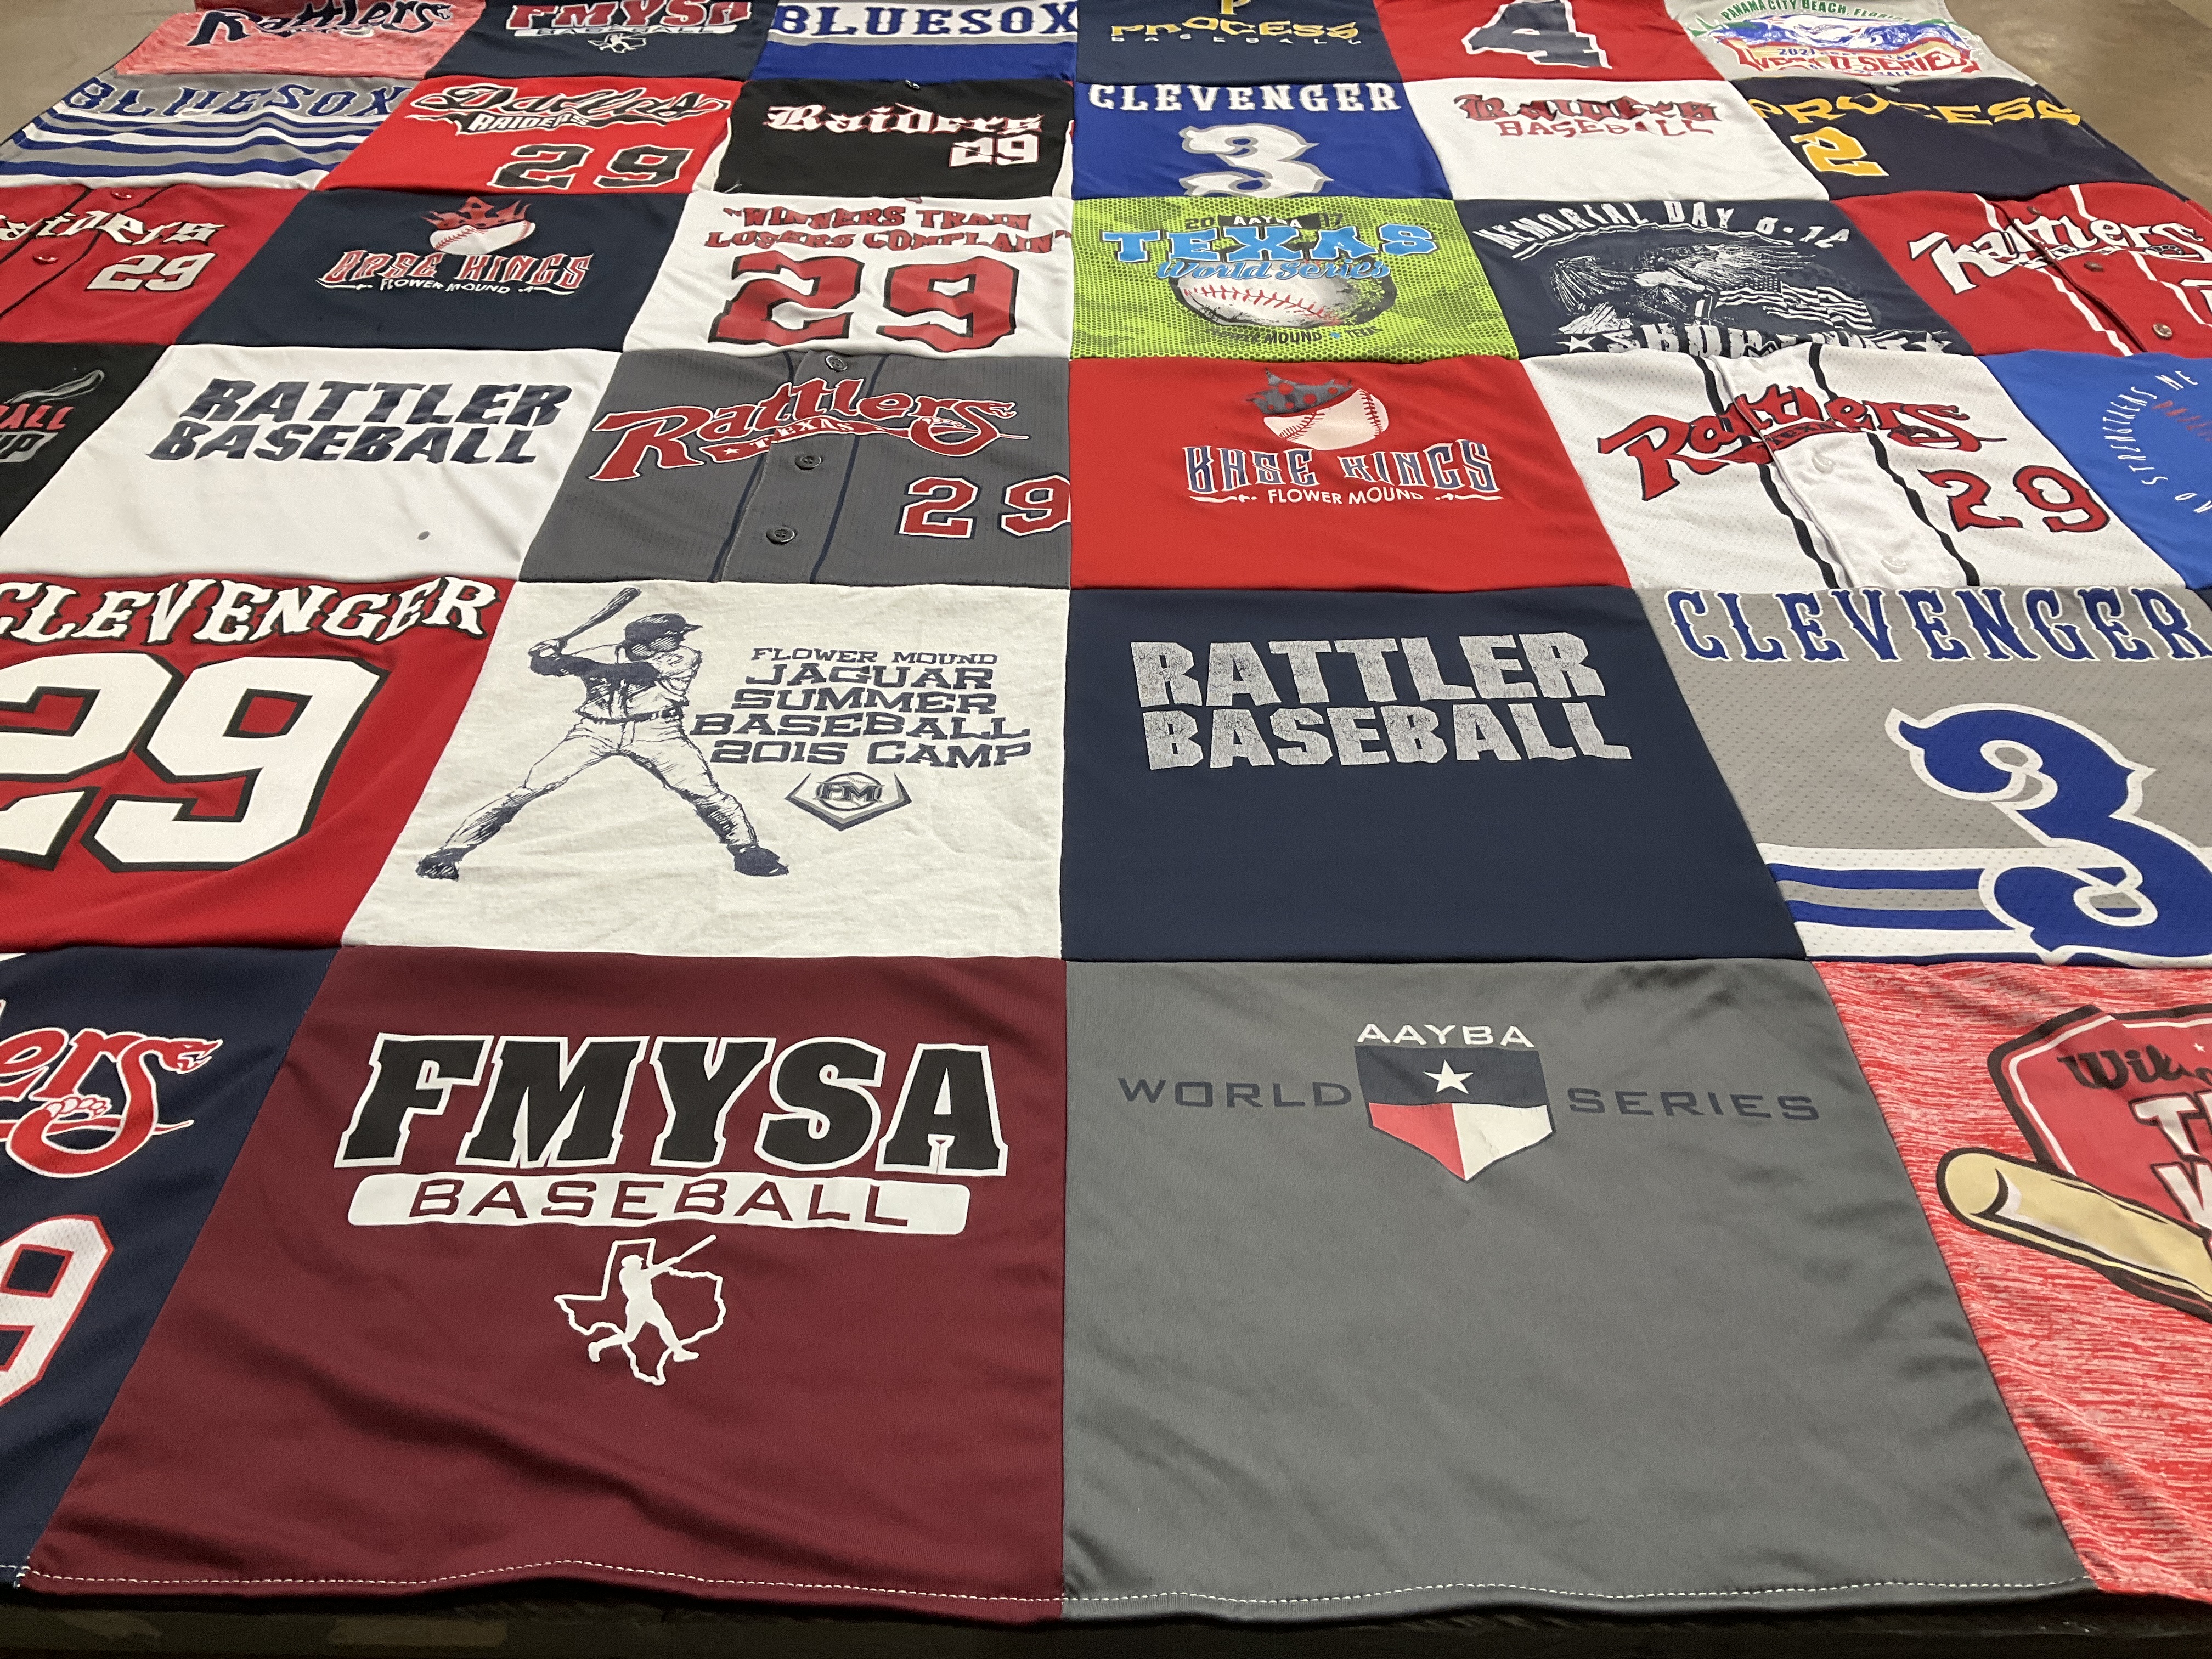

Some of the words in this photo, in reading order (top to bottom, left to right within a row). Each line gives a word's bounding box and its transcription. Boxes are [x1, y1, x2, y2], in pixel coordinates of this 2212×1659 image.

[506, 0, 752, 30] FMYSA
[771, 2, 1077, 36] BLUESOX
[1720, 0, 1767, 21] PANAMA
[1768, 0, 1797, 10] CITY
[61, 77, 413, 117] BLUESOX
[1089, 82, 1401, 111] CLEVENGER
[468, 111, 590, 131] RAIDERS
[763, 102, 1045, 134] Raiders
[487, 143, 694, 190] 29
[1179, 122, 1334, 196] 3
[1790, 127, 1889, 176] 2
[0, 210, 225, 246] aiders
[915, 208, 1031, 230] TRAIN
[1472, 202, 1649, 250] MEMORIAL
[1663, 201, 1734, 229] DAY
[704, 230, 855, 249] LOSERS
[1102, 223, 1438, 264] TEXAS
[84, 252, 217, 292] 29
[380, 278, 443, 291] FLOWER
[445, 283, 511, 295] MOUND
[1155, 259, 1273, 280] World
[1275, 259, 1392, 280] Series
[707, 250, 1020, 353] 29
[1263, 330, 1322, 345] MOUND
[0, 403, 76, 430] ALL
[179, 377, 573, 427] RATTLER
[145, 420, 538, 464] BASEBALL
[588, 377, 1029, 482] Rattlers
[749, 417, 855, 449] TEXAS
[1597, 384, 2007, 503] Rattlers
[1182, 445, 1319, 494] BASE
[1336, 438, 1501, 494] KINGS
[897, 473, 1071, 540] 29
[1267, 488, 1344, 505] FLOWER
[1348, 486, 1425, 505] MOUND
[1917, 464, 2111, 533] 29
[1665, 586, 2212, 663] CLEVENGER
[744, 662, 994, 690] JAGUAR
[751, 647, 878, 664] FLOWER
[891, 651, 998, 665] MOUND
[1131, 631, 1606, 708] RATTLER
[730, 686, 997, 715] SUMMER
[689, 712, 1031, 740] BASEBALL
[1142, 701, 1633, 770] BASEBALL
[0, 650, 392, 873] 29
[709, 739, 849, 765] 2015
[867, 740, 1032, 769] CAMP
[816, 781, 885, 805] FM
[1884, 703, 2212, 968] 3
[1355, 1022, 1536, 1050] AAYBA
[333, 1032, 1009, 1177] FMYSA
[1117, 1076, 1354, 1109] WORLD
[1568, 1086, 1820, 1121] SERIES
[408, 1178, 909, 1227] BASEBALL
